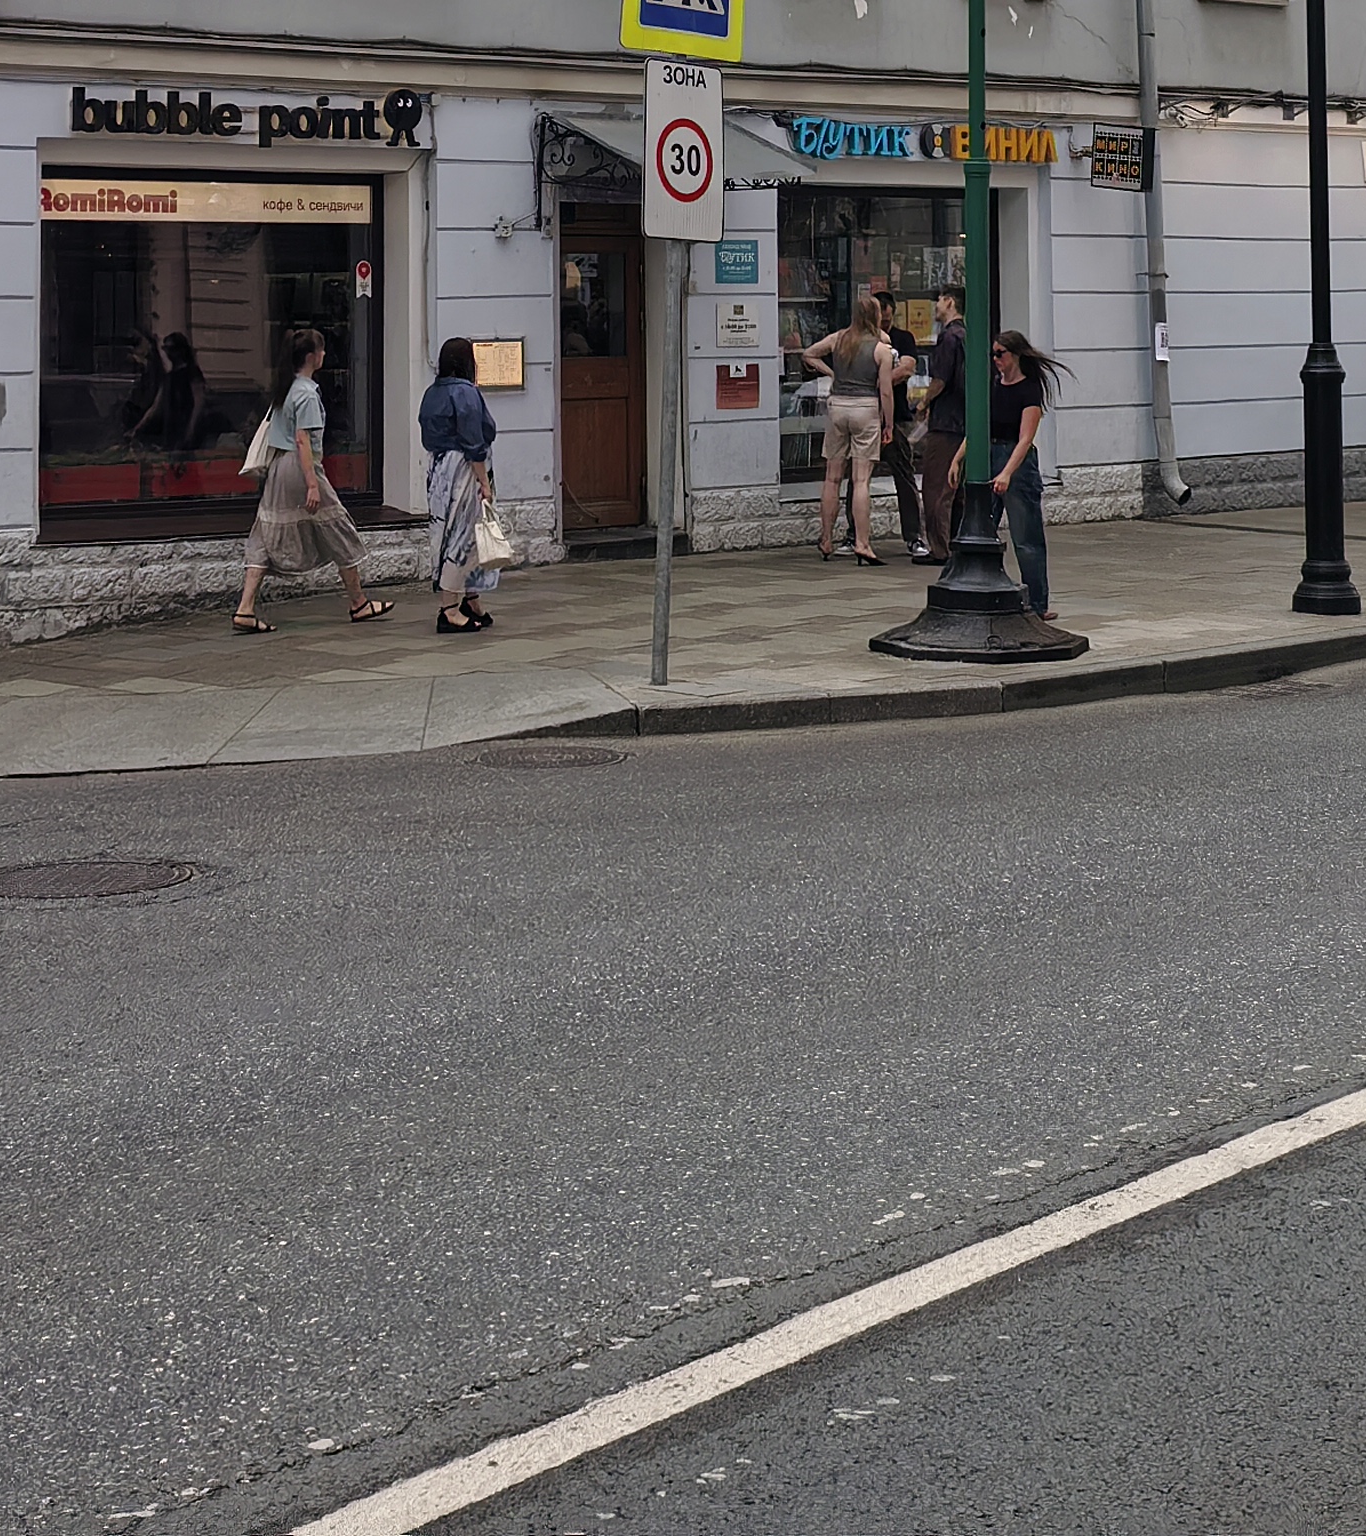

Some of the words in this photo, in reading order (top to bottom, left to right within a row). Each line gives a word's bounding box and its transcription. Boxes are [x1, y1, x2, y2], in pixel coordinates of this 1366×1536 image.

[663, 64, 707, 89] ЗОНА
[71, 86, 243, 137] bubble
[258, 95, 381, 148] point
[1096, 138, 1129, 152] МИР
[670, 143, 701, 177] 30
[1095, 161, 1140, 176] КИНО
[40, 187, 178, 214] RomiRomi
[263, 198, 293, 214] кофе
[296, 198, 306, 212] &
[309, 200, 364, 214] сендвичи
